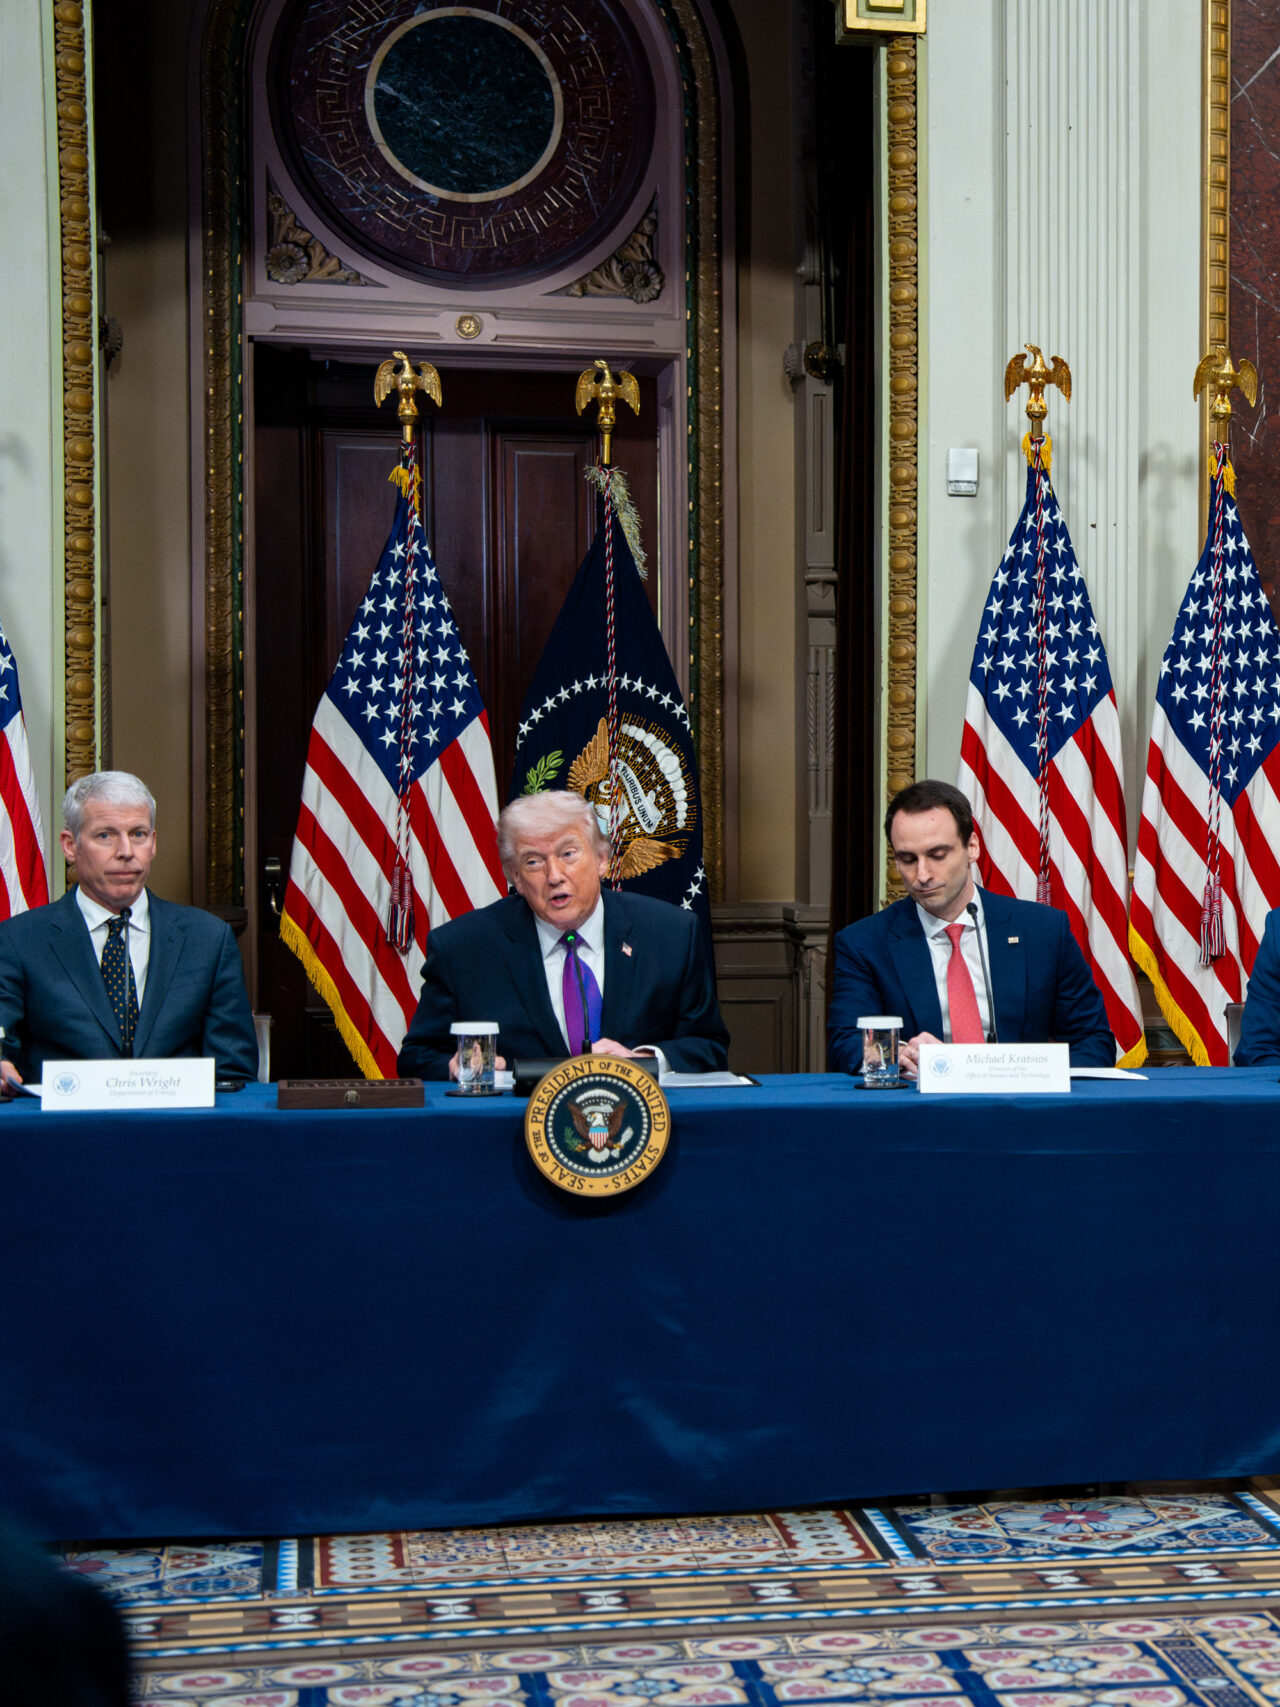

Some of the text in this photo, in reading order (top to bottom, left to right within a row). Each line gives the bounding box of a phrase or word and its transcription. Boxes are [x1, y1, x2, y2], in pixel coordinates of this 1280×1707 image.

[966, 1053, 1049, 1064] Michael Kratsios
[105, 1076, 182, 1090] Chris Wright
[530, 1060, 666, 1190] SEAL OF THE PRESIDENT OF THE UNITED STATES
